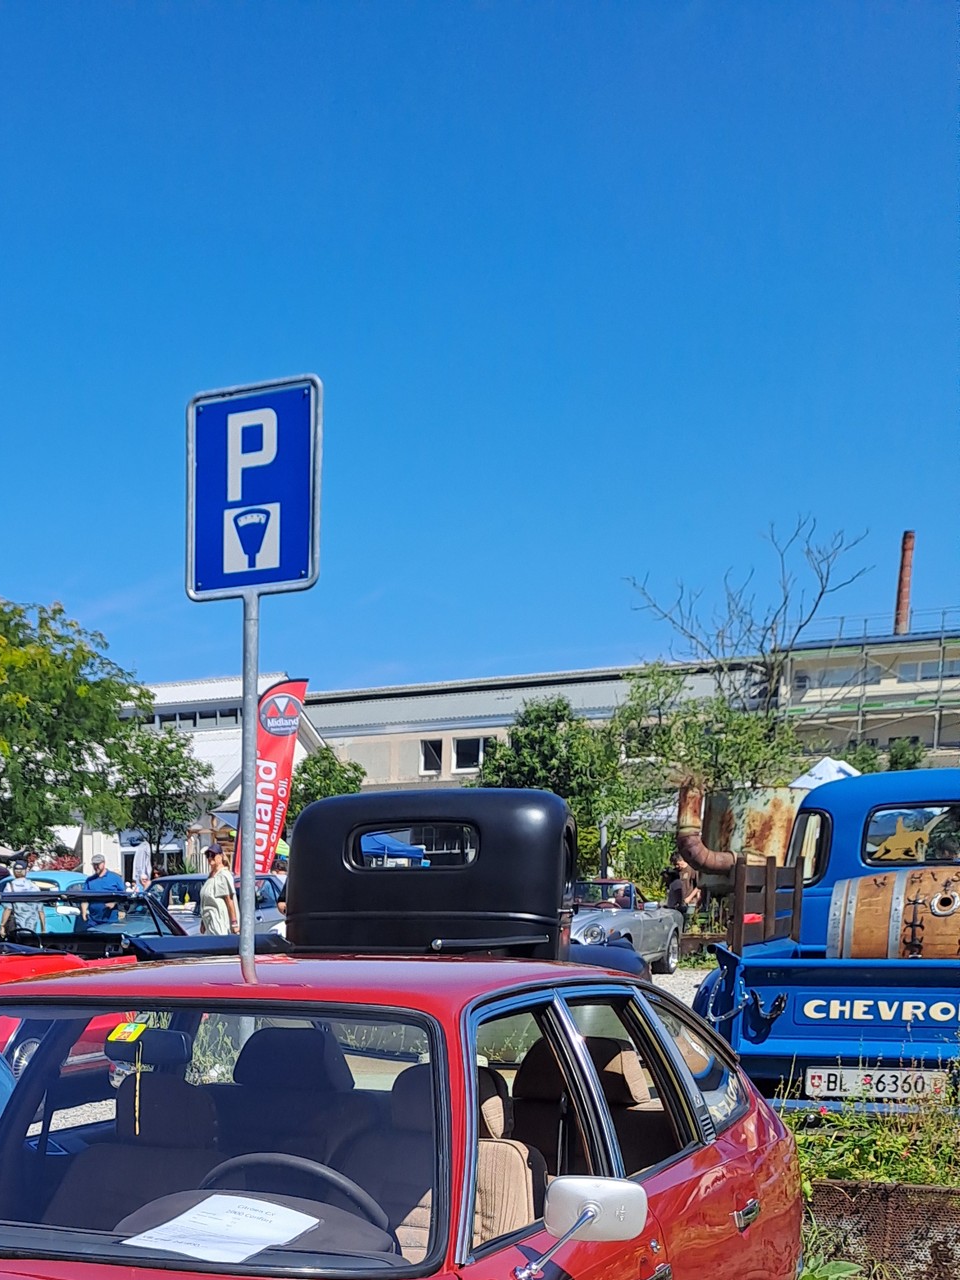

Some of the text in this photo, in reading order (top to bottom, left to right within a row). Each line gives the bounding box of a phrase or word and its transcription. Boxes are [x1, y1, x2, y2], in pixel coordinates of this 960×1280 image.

[226, 407, 278, 502] P
[267, 717, 299, 728] Midland
[277, 777, 289, 798] Oil.
[803, 999, 960, 1022] CHEVRO
[826, 1072, 848, 1092] BL
